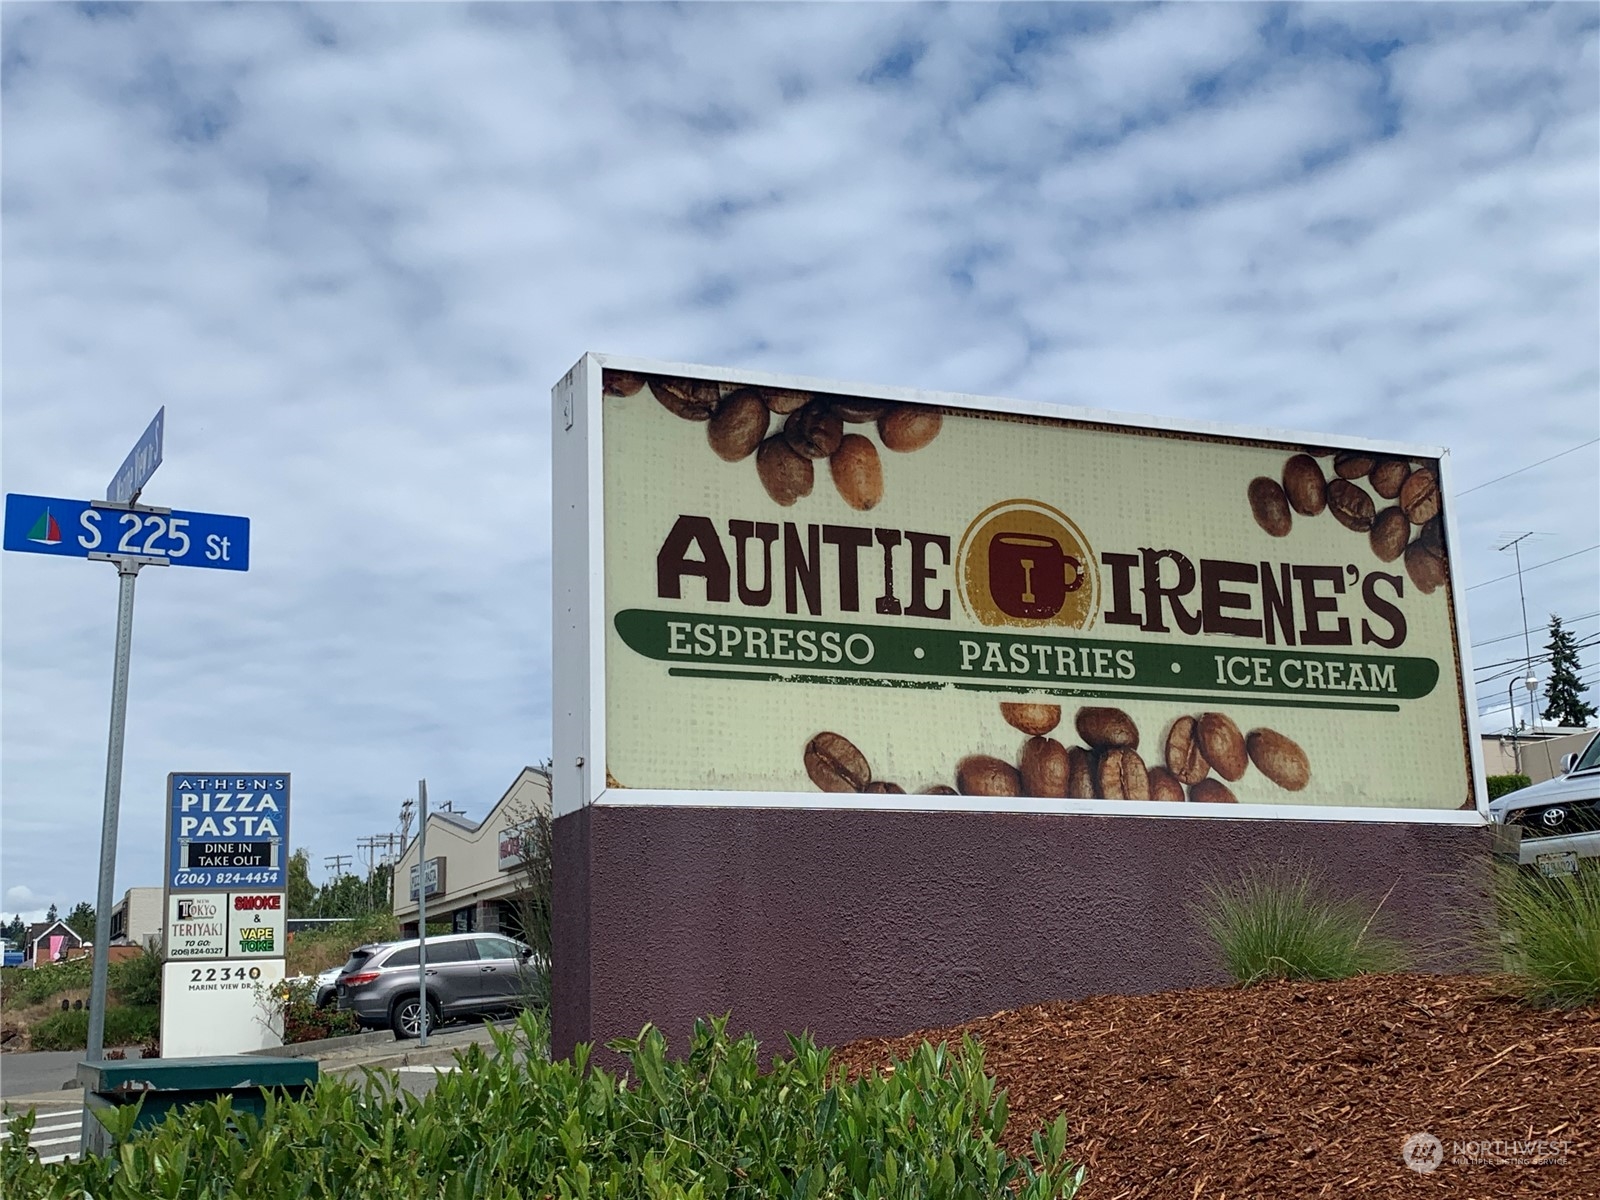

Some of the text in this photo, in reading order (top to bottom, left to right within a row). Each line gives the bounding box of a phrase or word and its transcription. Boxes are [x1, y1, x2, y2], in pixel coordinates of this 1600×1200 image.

[77, 509, 231, 561] S 225 St
[656, 514, 1407, 649] AUNTIE IRENE'S
[667, 621, 1398, 693] ESPRESSO PASTRIES ICE CREAM
[181, 793, 279, 812] PIZZA
[180, 816, 279, 836] PASTA
[205, 843, 252, 853] DINE IN
[198, 855, 261, 866] TAKE OUT
[174, 872, 278, 886] (206) 824-4454
[234, 895, 281, 911] SMOKE
[253, 914, 261, 923] &
[171, 923, 223, 937] TERIYAKI
[240, 927, 274, 940] VAPE
[239, 940, 274, 952] TOKE
[190, 967, 261, 982] 22340
[188, 983, 218, 991] MARINE
[220, 982, 239, 990] VIEW
